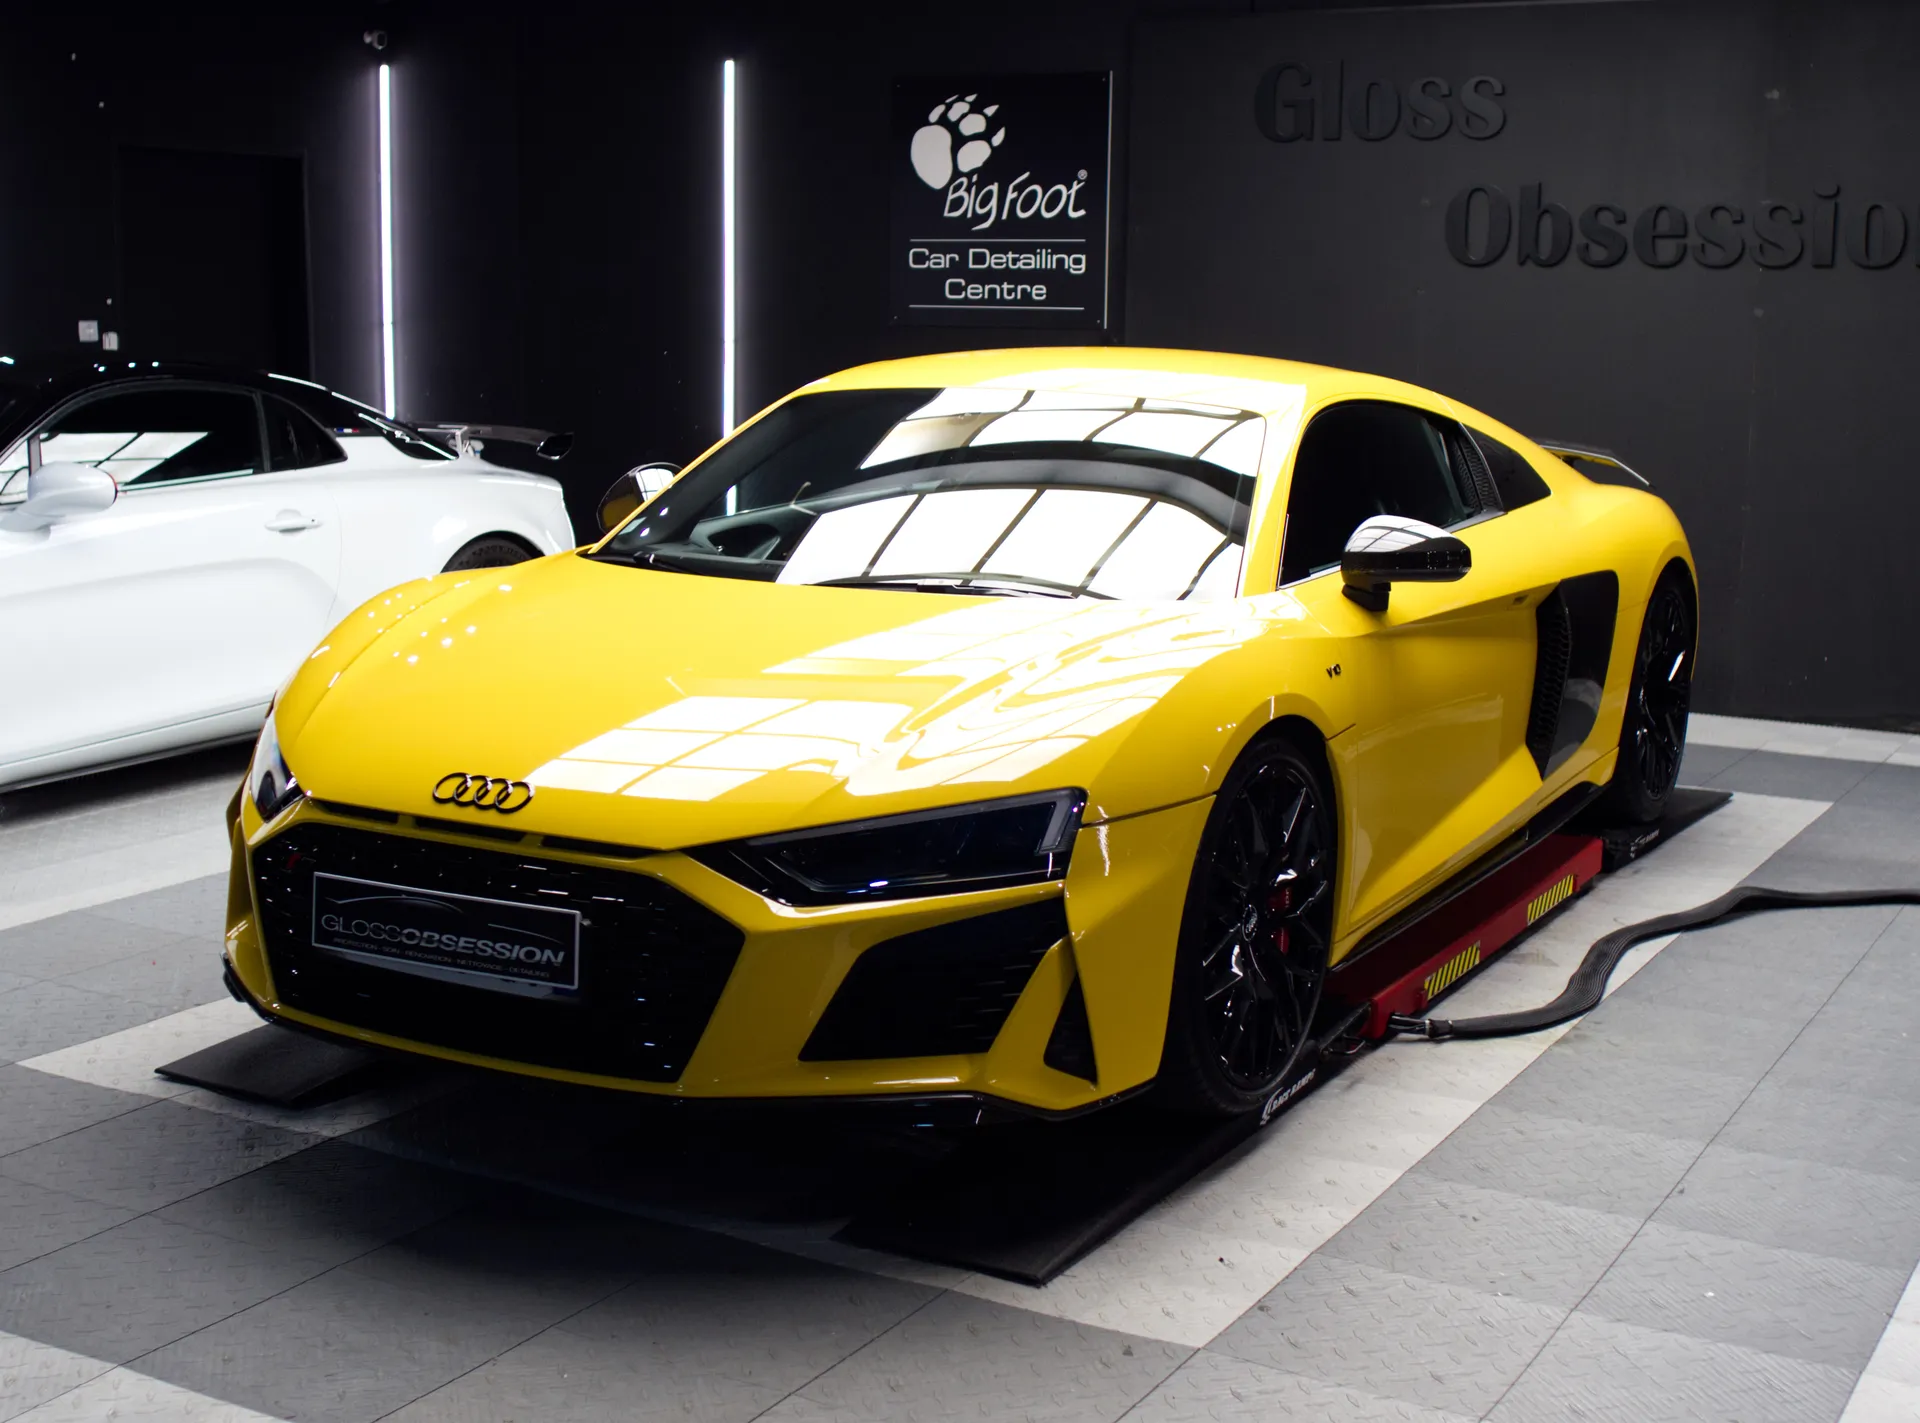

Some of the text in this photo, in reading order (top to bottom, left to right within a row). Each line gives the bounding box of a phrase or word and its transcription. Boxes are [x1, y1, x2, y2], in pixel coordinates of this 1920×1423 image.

[1253, 59, 1507, 143] Gloss
[1444, 181, 1920, 270] Obsessio
[908, 248, 1086, 274] Car Detailing
[944, 278, 1047, 300] Centre
[321, 914, 565, 967] GLOSSOBSESSION
